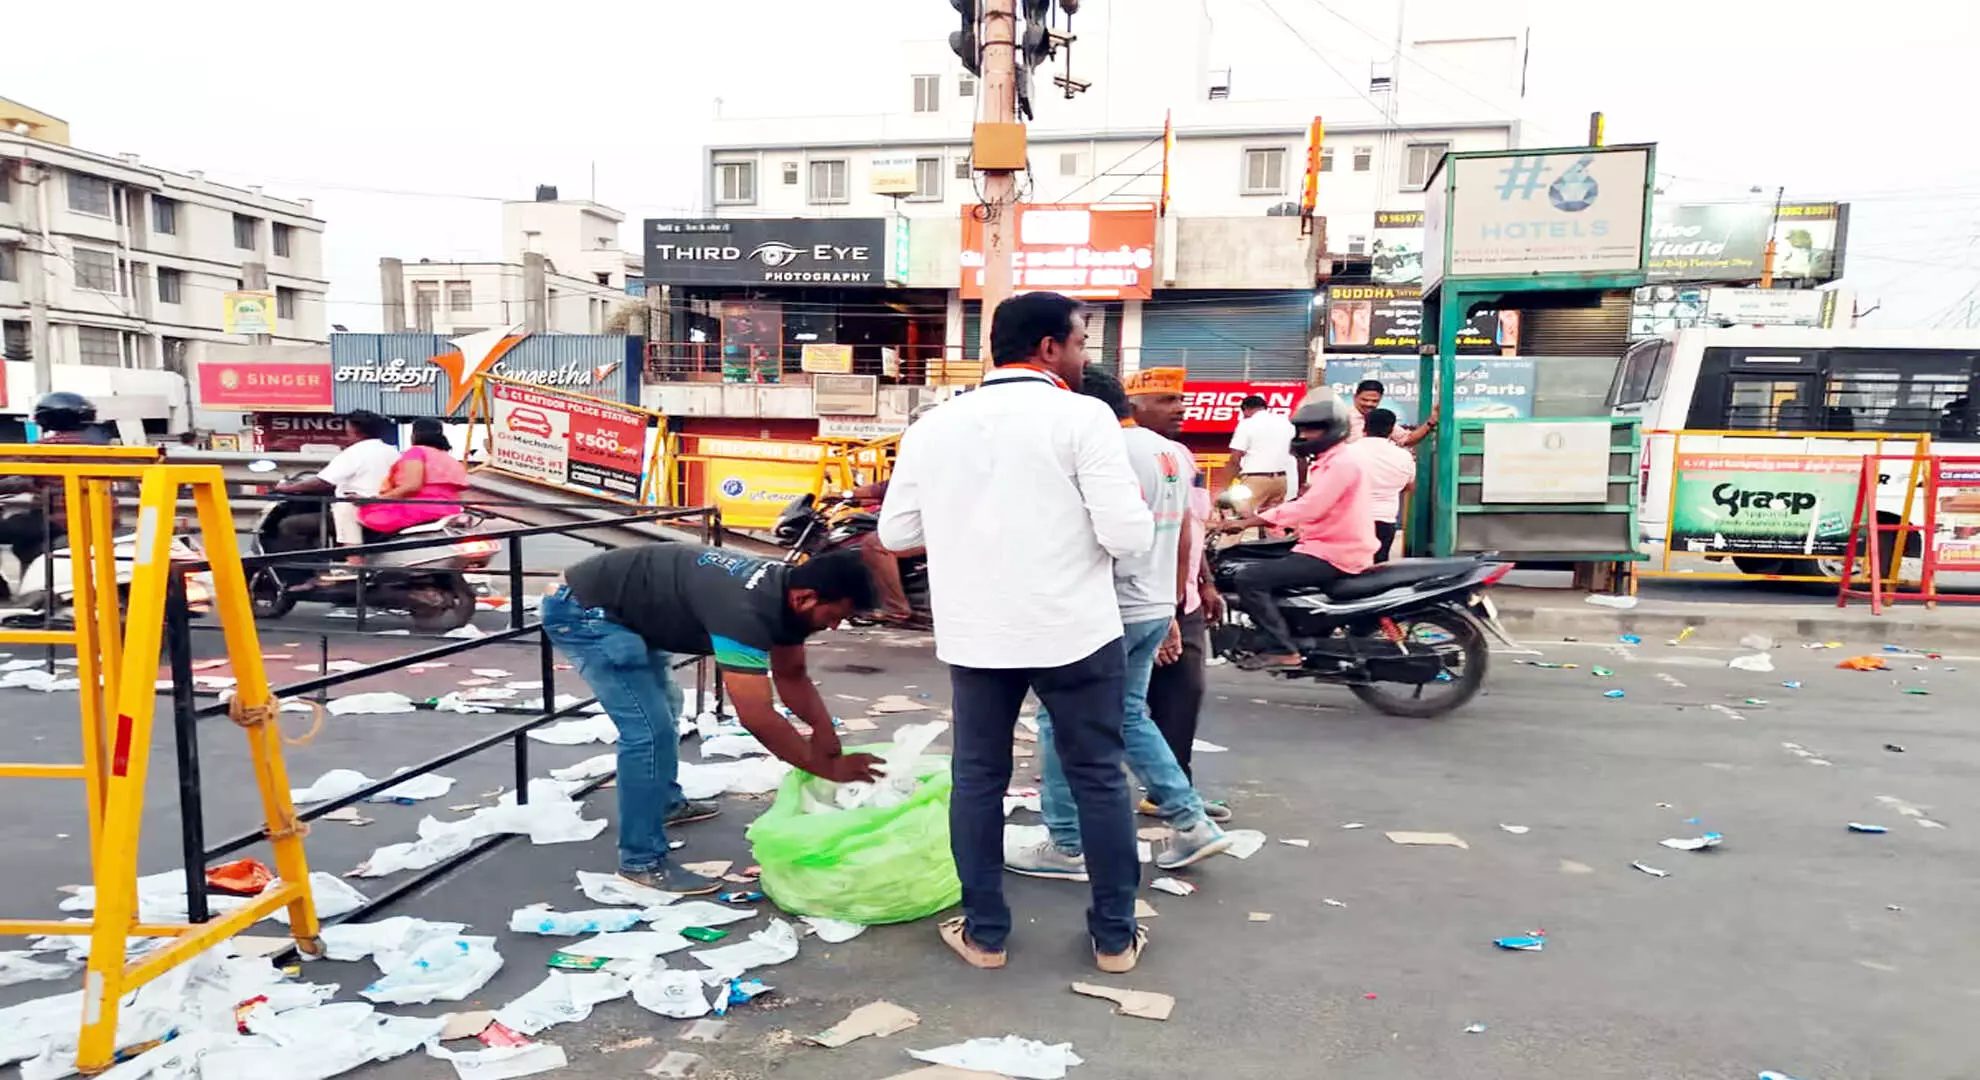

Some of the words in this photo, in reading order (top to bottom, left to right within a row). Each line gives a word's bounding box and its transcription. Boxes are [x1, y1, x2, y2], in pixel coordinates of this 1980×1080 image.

[1481, 220, 1612, 241] HOTELS
[656, 245, 740, 260] THIRD
[813, 245, 869, 260] EYE
[765, 272, 870, 281] PHOTOGRAPHY
[1333, 288, 1395, 299] BUDDHA
[247, 373, 321, 386] SINGER
[492, 361, 592, 388] Sangeetha
[1475, 384, 1526, 396] Parts
[272, 417, 348, 430] SING
[601, 411, 639, 426] STATION
